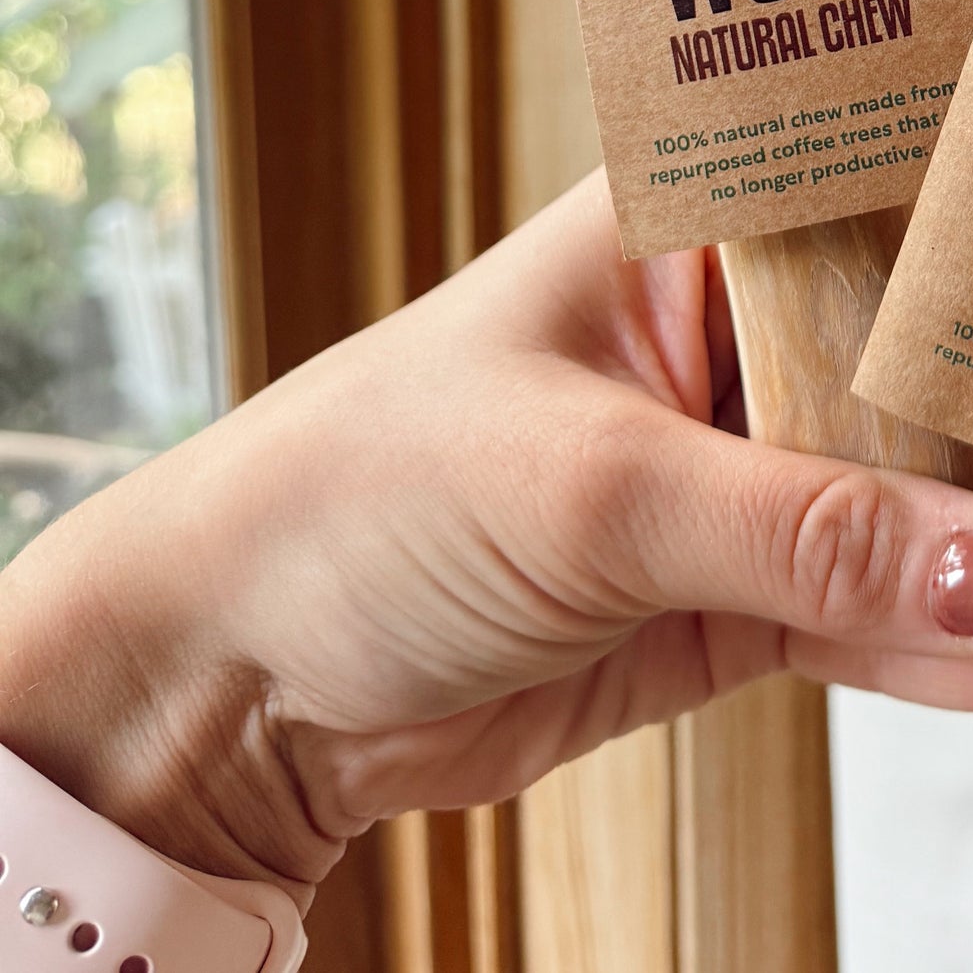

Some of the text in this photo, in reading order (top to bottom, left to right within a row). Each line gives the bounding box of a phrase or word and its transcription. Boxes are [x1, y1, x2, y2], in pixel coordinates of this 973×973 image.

[670, 9, 817, 85] NATURAL
[650, 112, 940, 186] repurposed coffee trees that
[654, 81, 958, 156] 100% natural chew made from
[711, 145, 929, 202] no longer productive.
